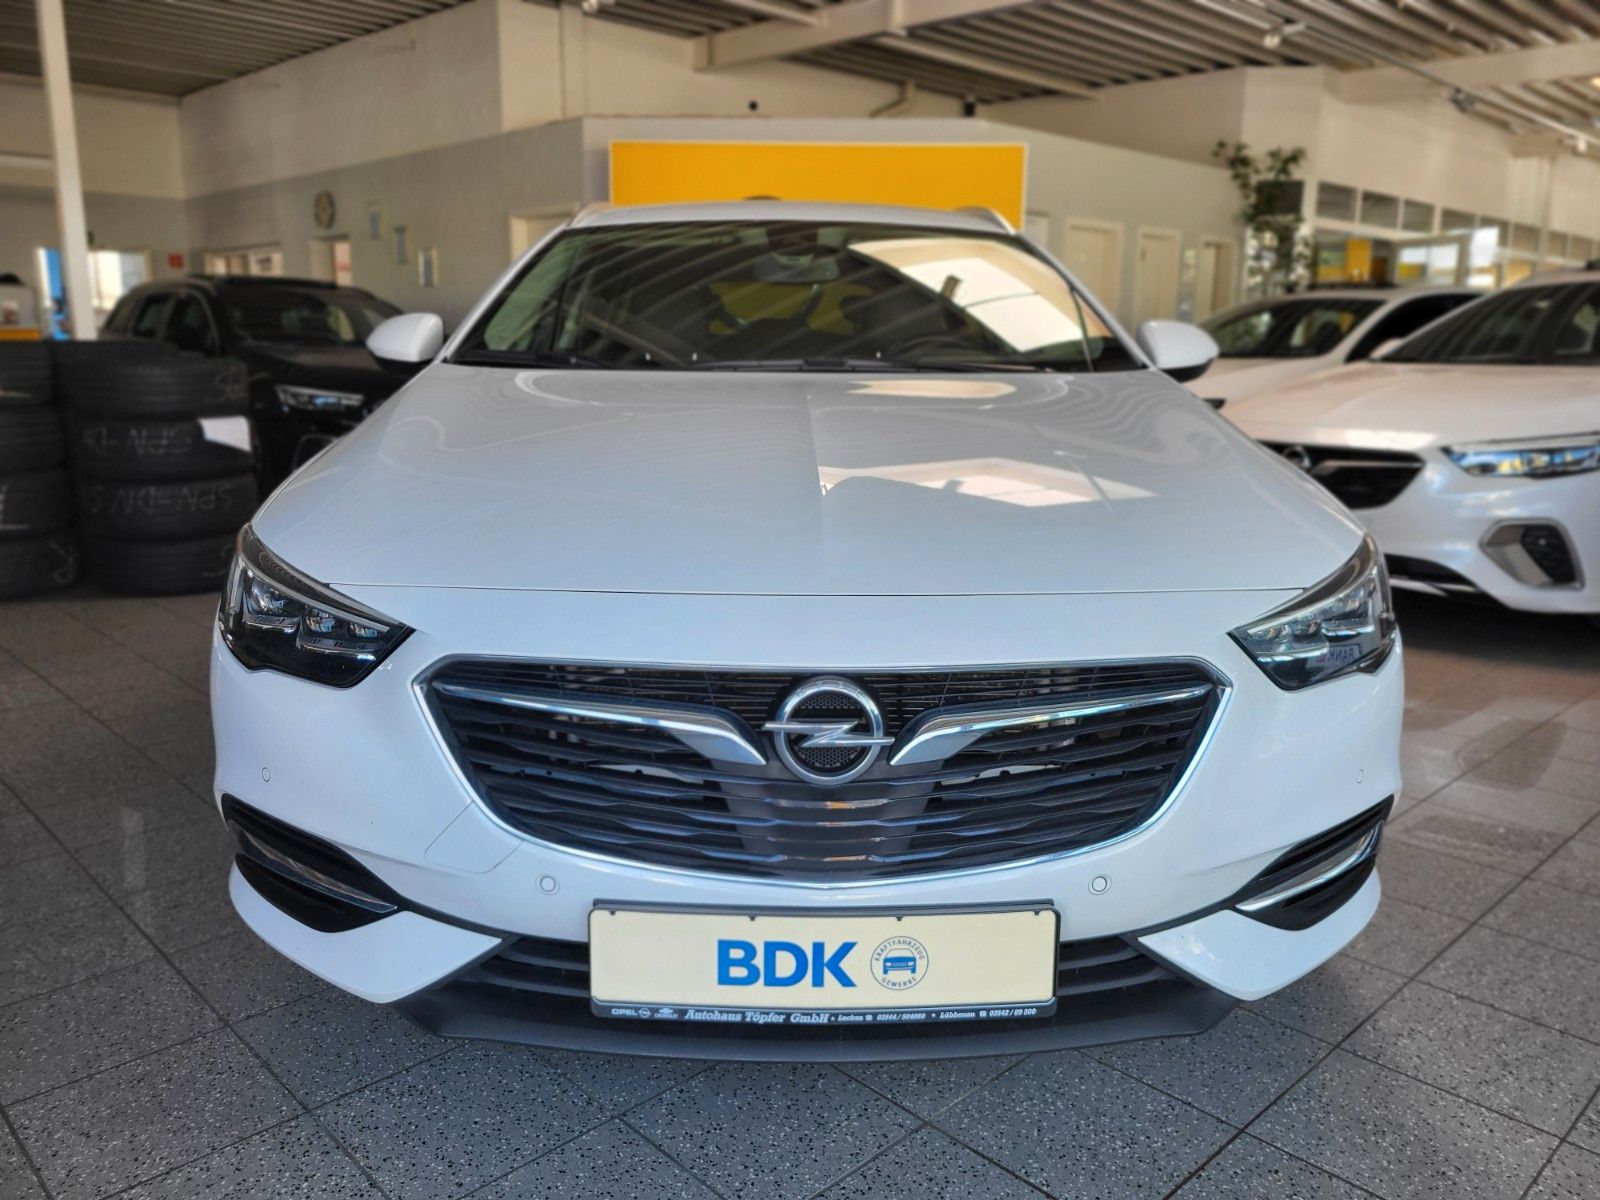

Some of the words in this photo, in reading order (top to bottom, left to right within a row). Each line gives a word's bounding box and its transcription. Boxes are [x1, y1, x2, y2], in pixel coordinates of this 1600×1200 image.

[717, 939, 858, 988] BDK
[611, 1008, 638, 1016] OPEL
[684, 1009, 742, 1021] Autohaus
[745, 1011, 786, 1023] Töpfer
[790, 1012, 830, 1023] GmbH
